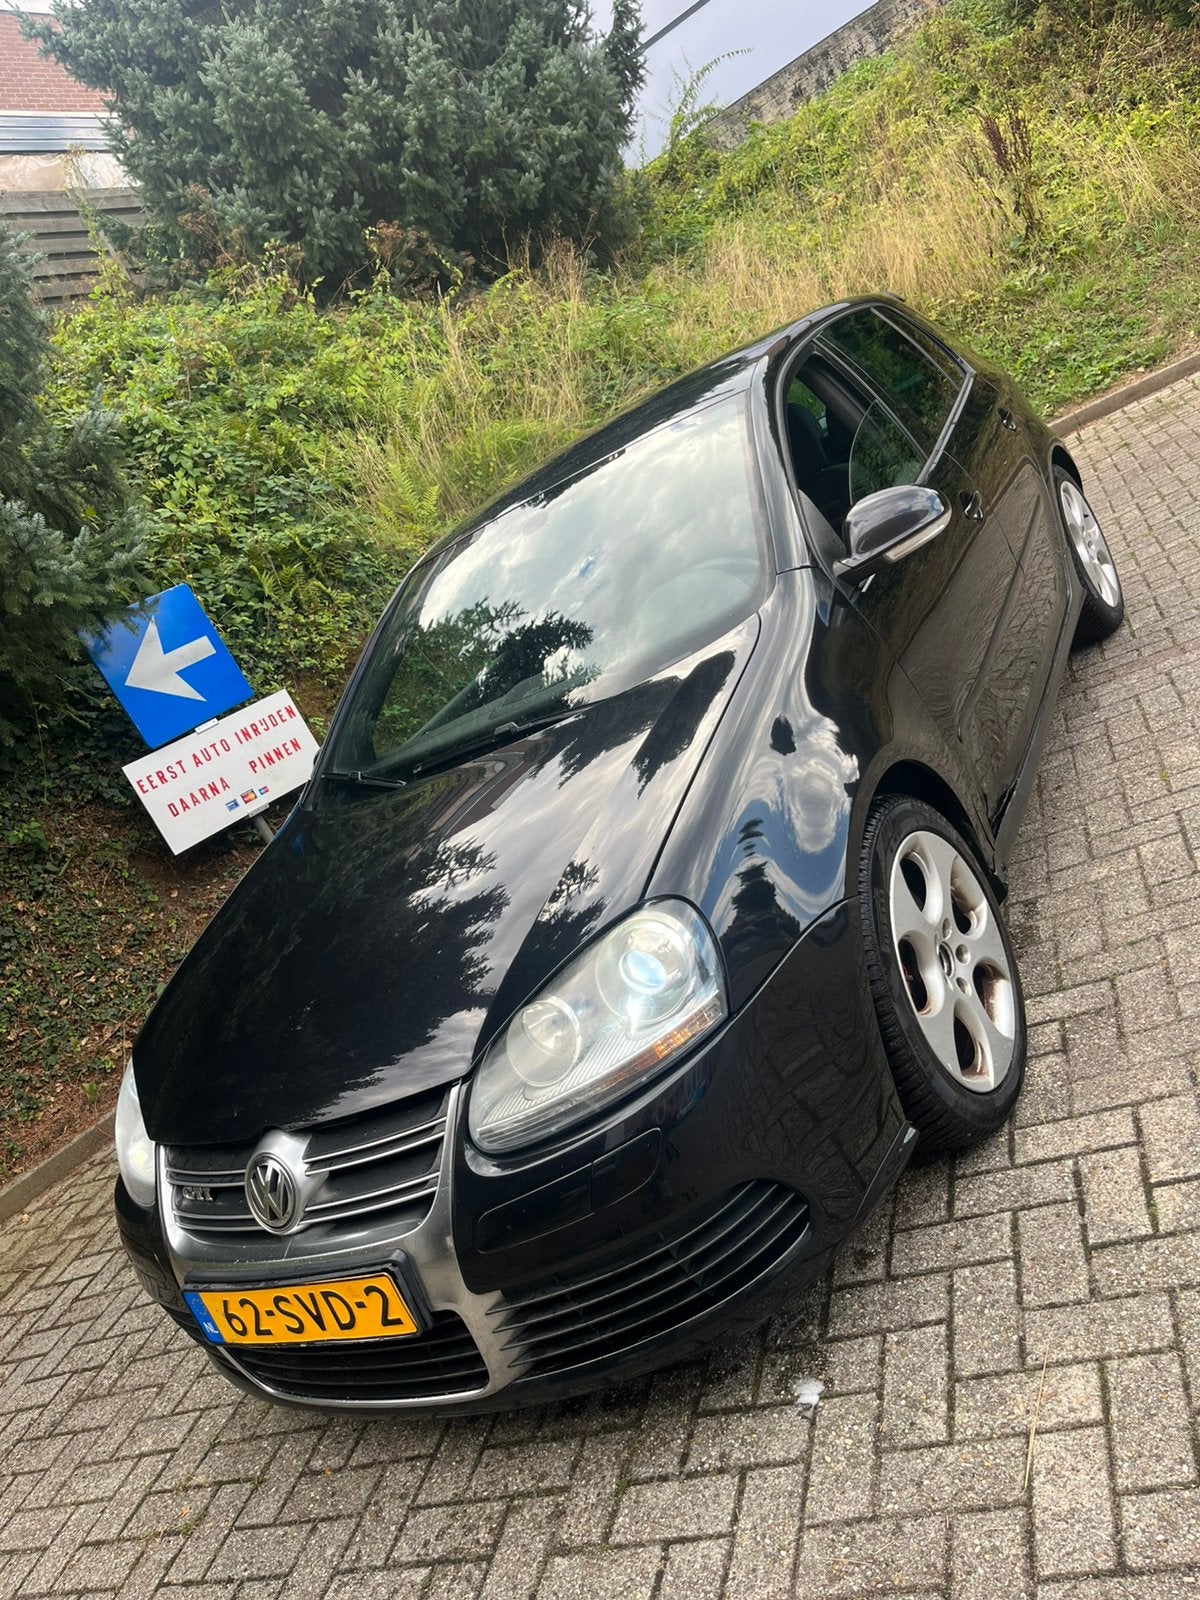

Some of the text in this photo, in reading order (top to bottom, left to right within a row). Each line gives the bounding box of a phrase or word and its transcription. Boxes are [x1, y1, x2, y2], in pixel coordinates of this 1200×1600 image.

[136, 760, 187, 794] EERST
[192, 738, 231, 768] AUTO
[167, 777, 231, 817] DAARNA
[248, 737, 302, 774] PINNEN
[182, 1186, 213, 1201] GTI
[248, 1156, 296, 1230] VW
[203, 1285, 403, 1336] NL 62-SVD-2
